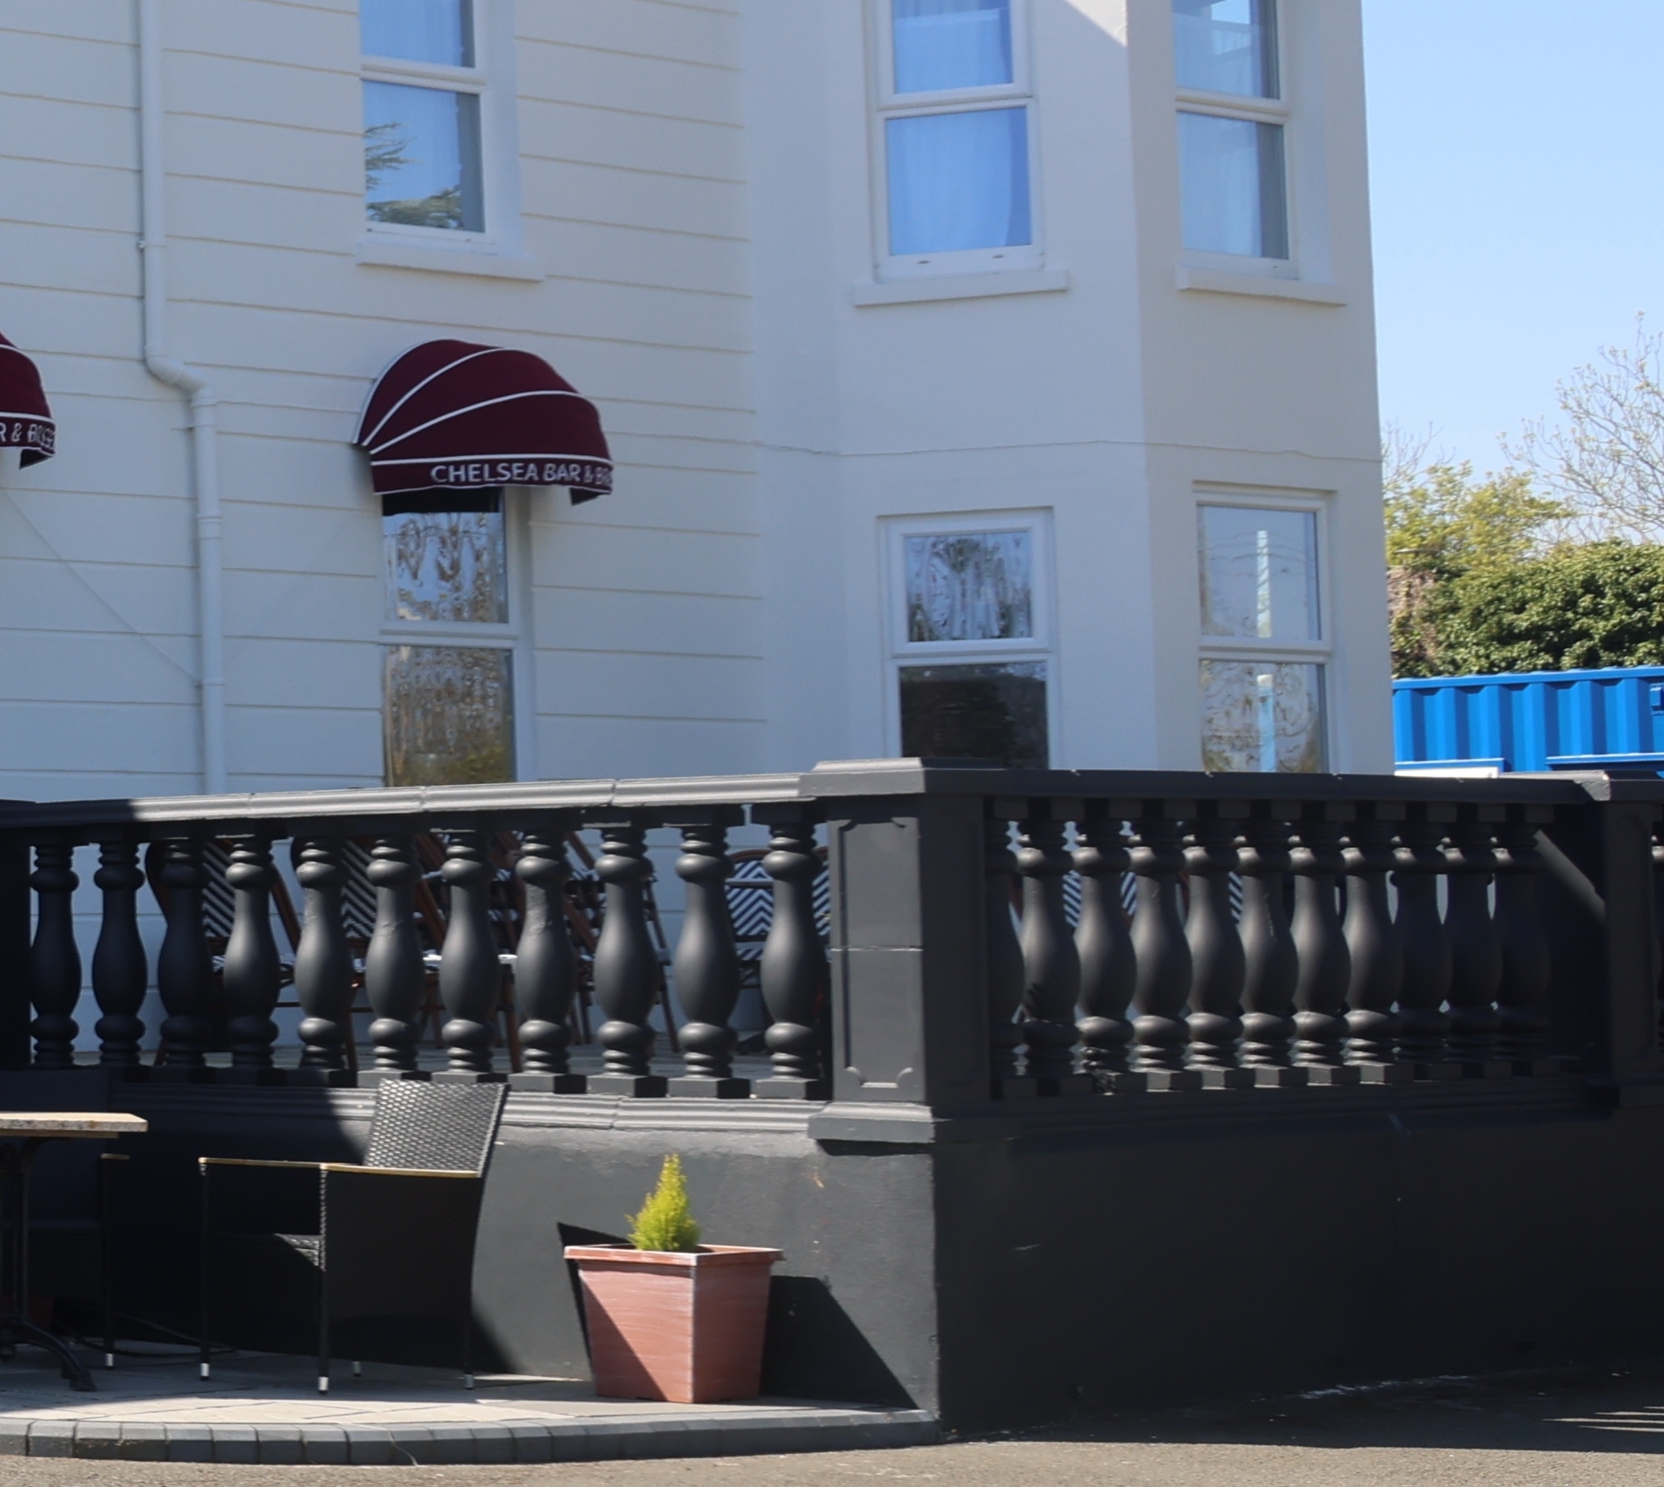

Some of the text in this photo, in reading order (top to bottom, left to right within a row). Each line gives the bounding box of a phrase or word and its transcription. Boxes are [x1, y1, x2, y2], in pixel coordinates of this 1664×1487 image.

[10, 422, 23, 443] &
[430, 462, 540, 483] CHELSEA
[543, 463, 581, 482] BAR
